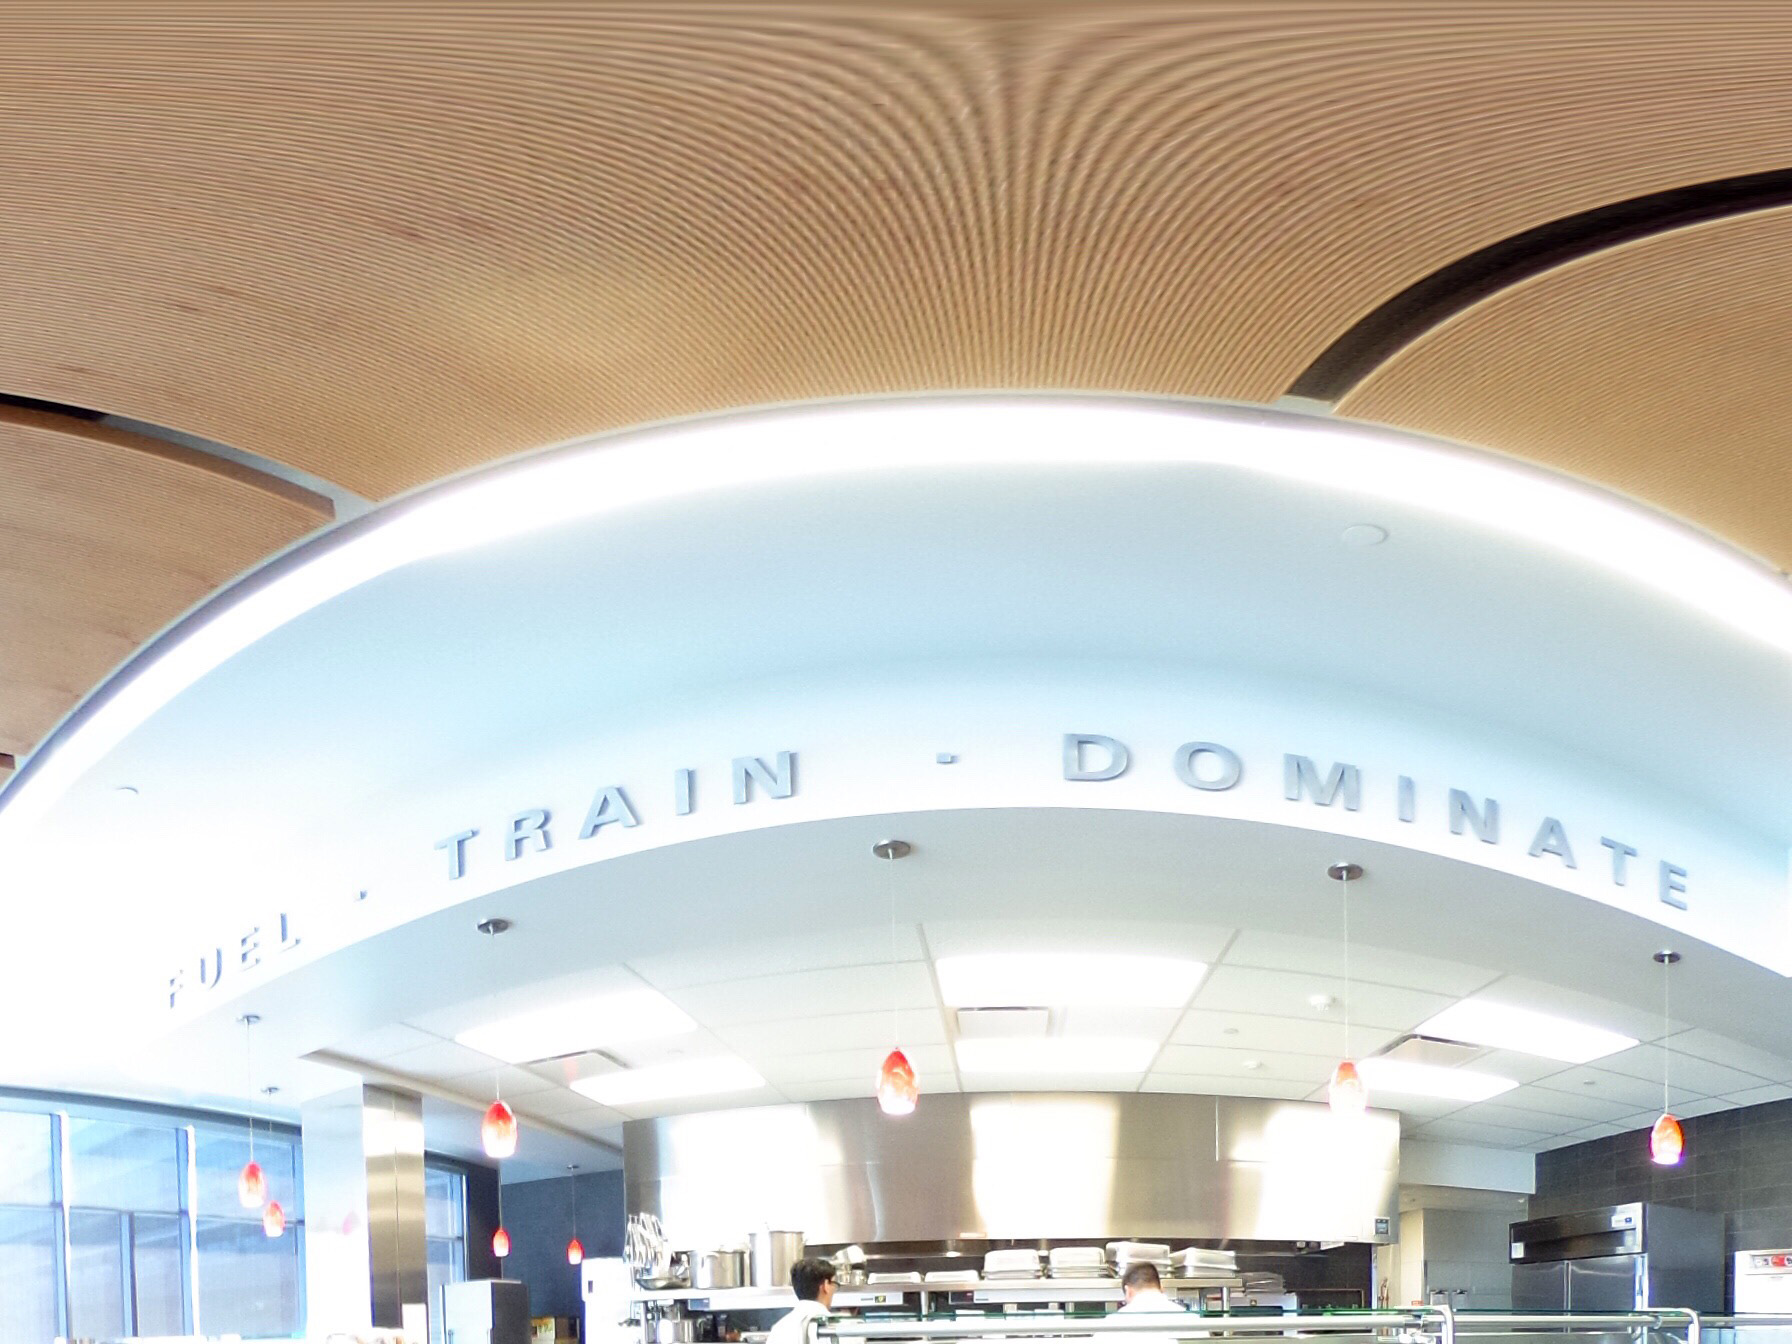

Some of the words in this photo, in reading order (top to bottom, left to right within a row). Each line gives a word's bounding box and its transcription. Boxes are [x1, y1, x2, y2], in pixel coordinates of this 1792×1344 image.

[168, 912, 301, 1009] FUEL
[434, 749, 799, 880] TRAIN
[1061, 732, 1690, 912] DOMINATE
